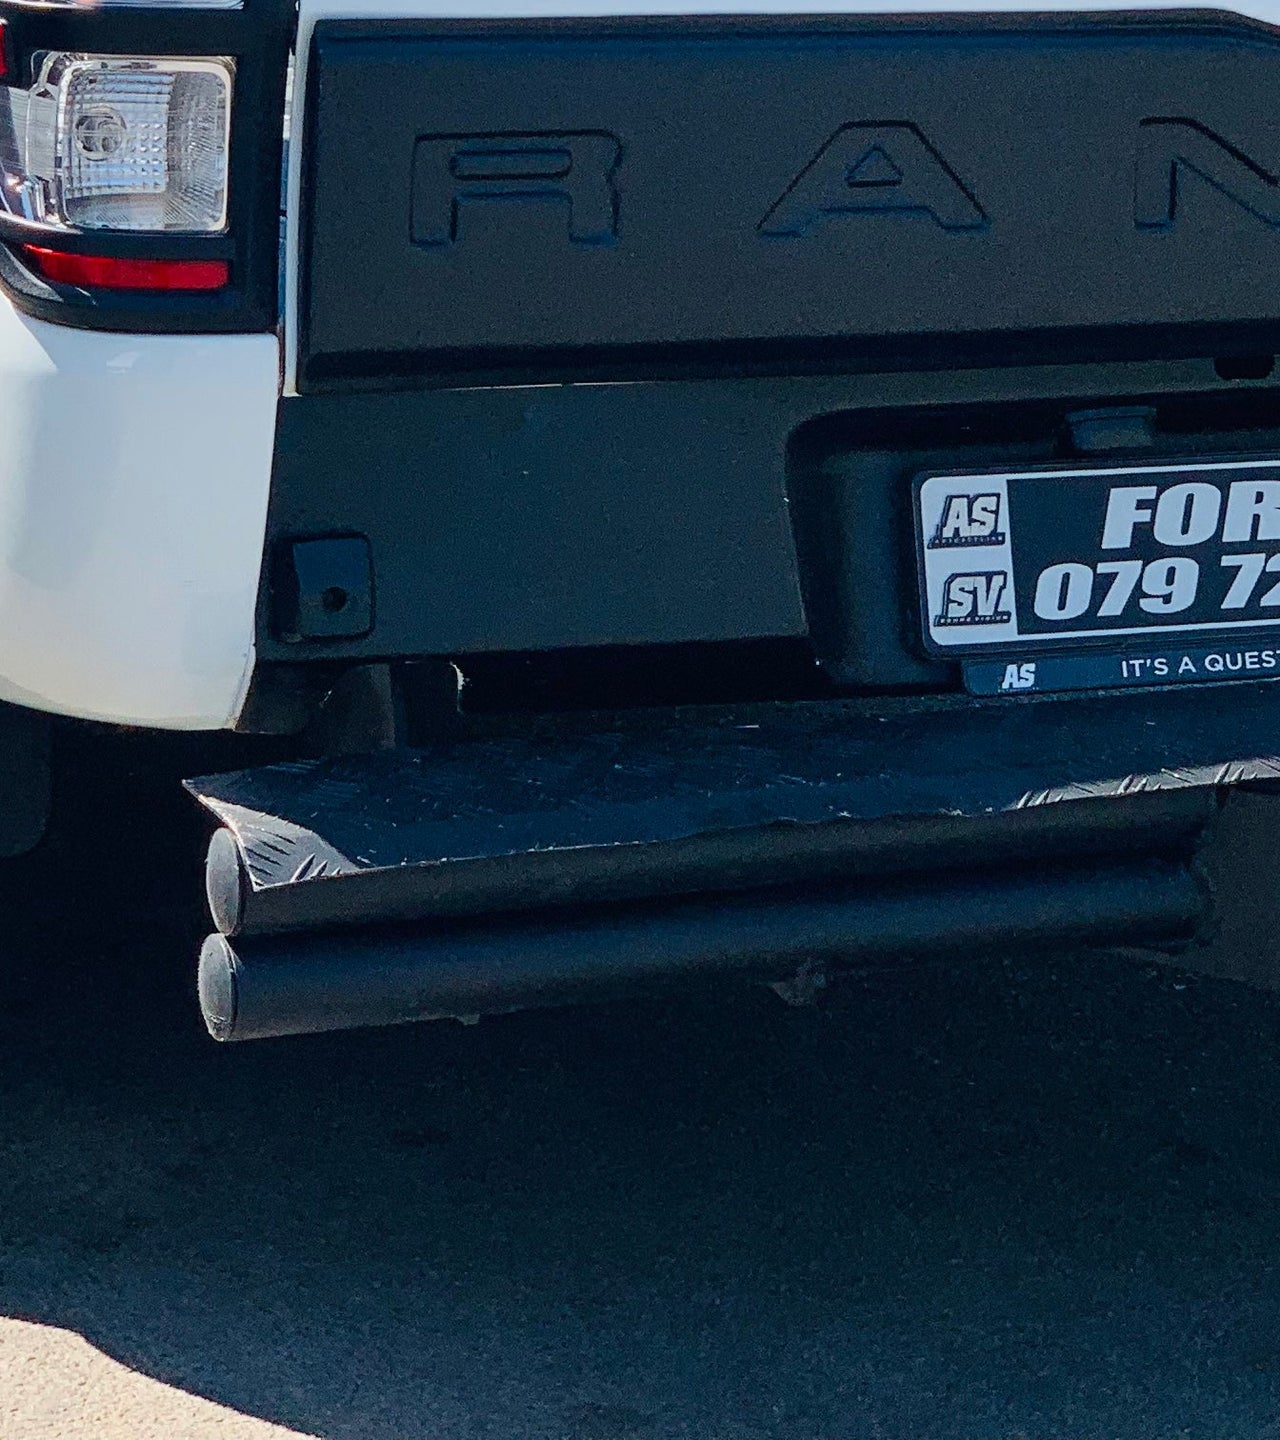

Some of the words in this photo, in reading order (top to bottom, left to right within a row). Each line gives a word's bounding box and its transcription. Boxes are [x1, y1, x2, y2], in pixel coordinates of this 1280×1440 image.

[942, 494, 1000, 538] AS
[946, 573, 1006, 618] SV
[1033, 556, 1200, 621] 079
[1001, 662, 1036, 690] AS
[1121, 657, 1169, 679] IT'S
[1178, 656, 1197, 674] A
